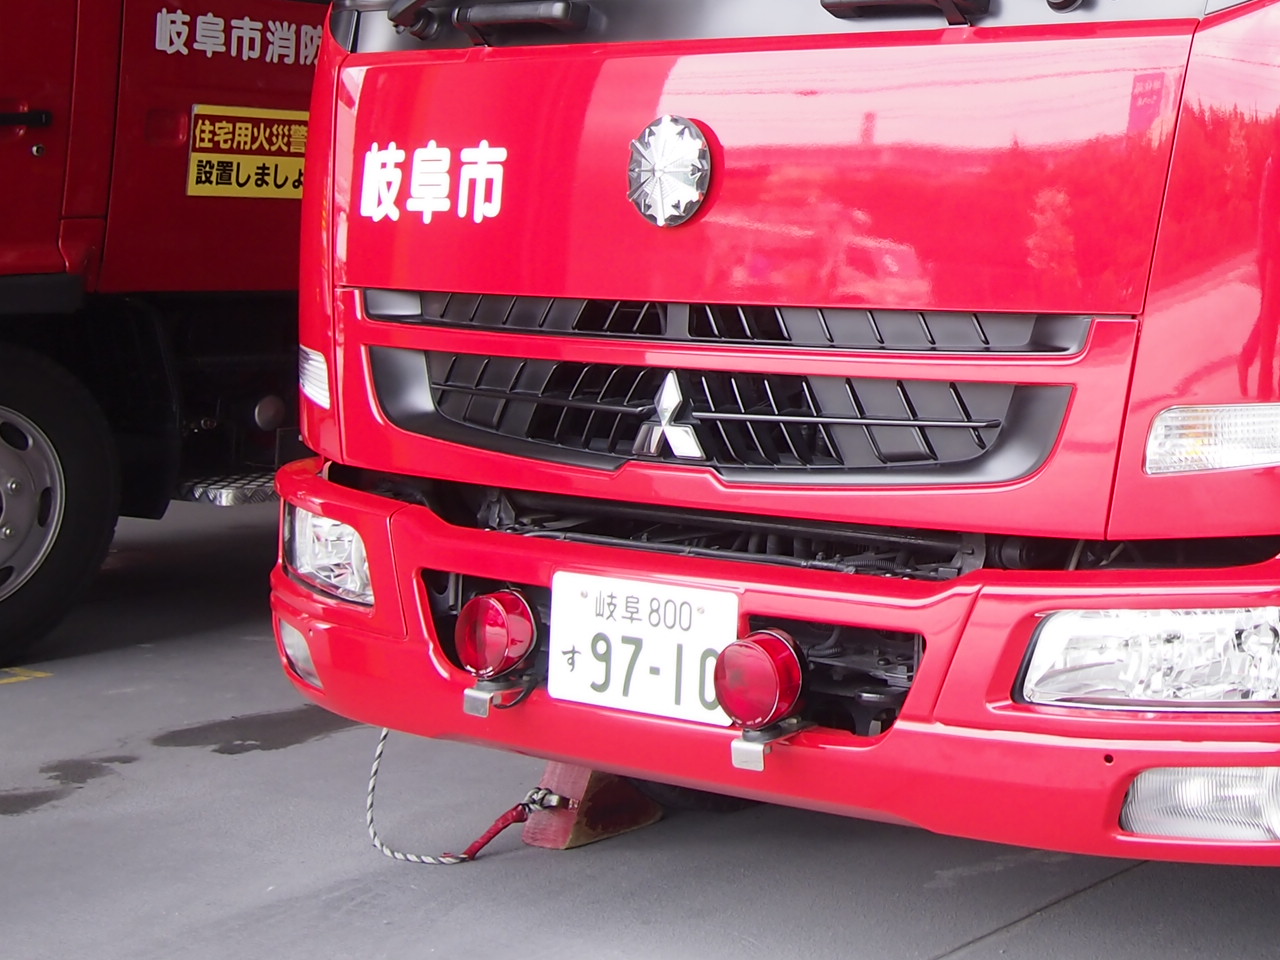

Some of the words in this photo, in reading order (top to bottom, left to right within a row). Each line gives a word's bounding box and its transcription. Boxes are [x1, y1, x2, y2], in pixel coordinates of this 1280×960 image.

[360, 139, 508, 224] 岐阜市
[562, 644, 582, 672] す
